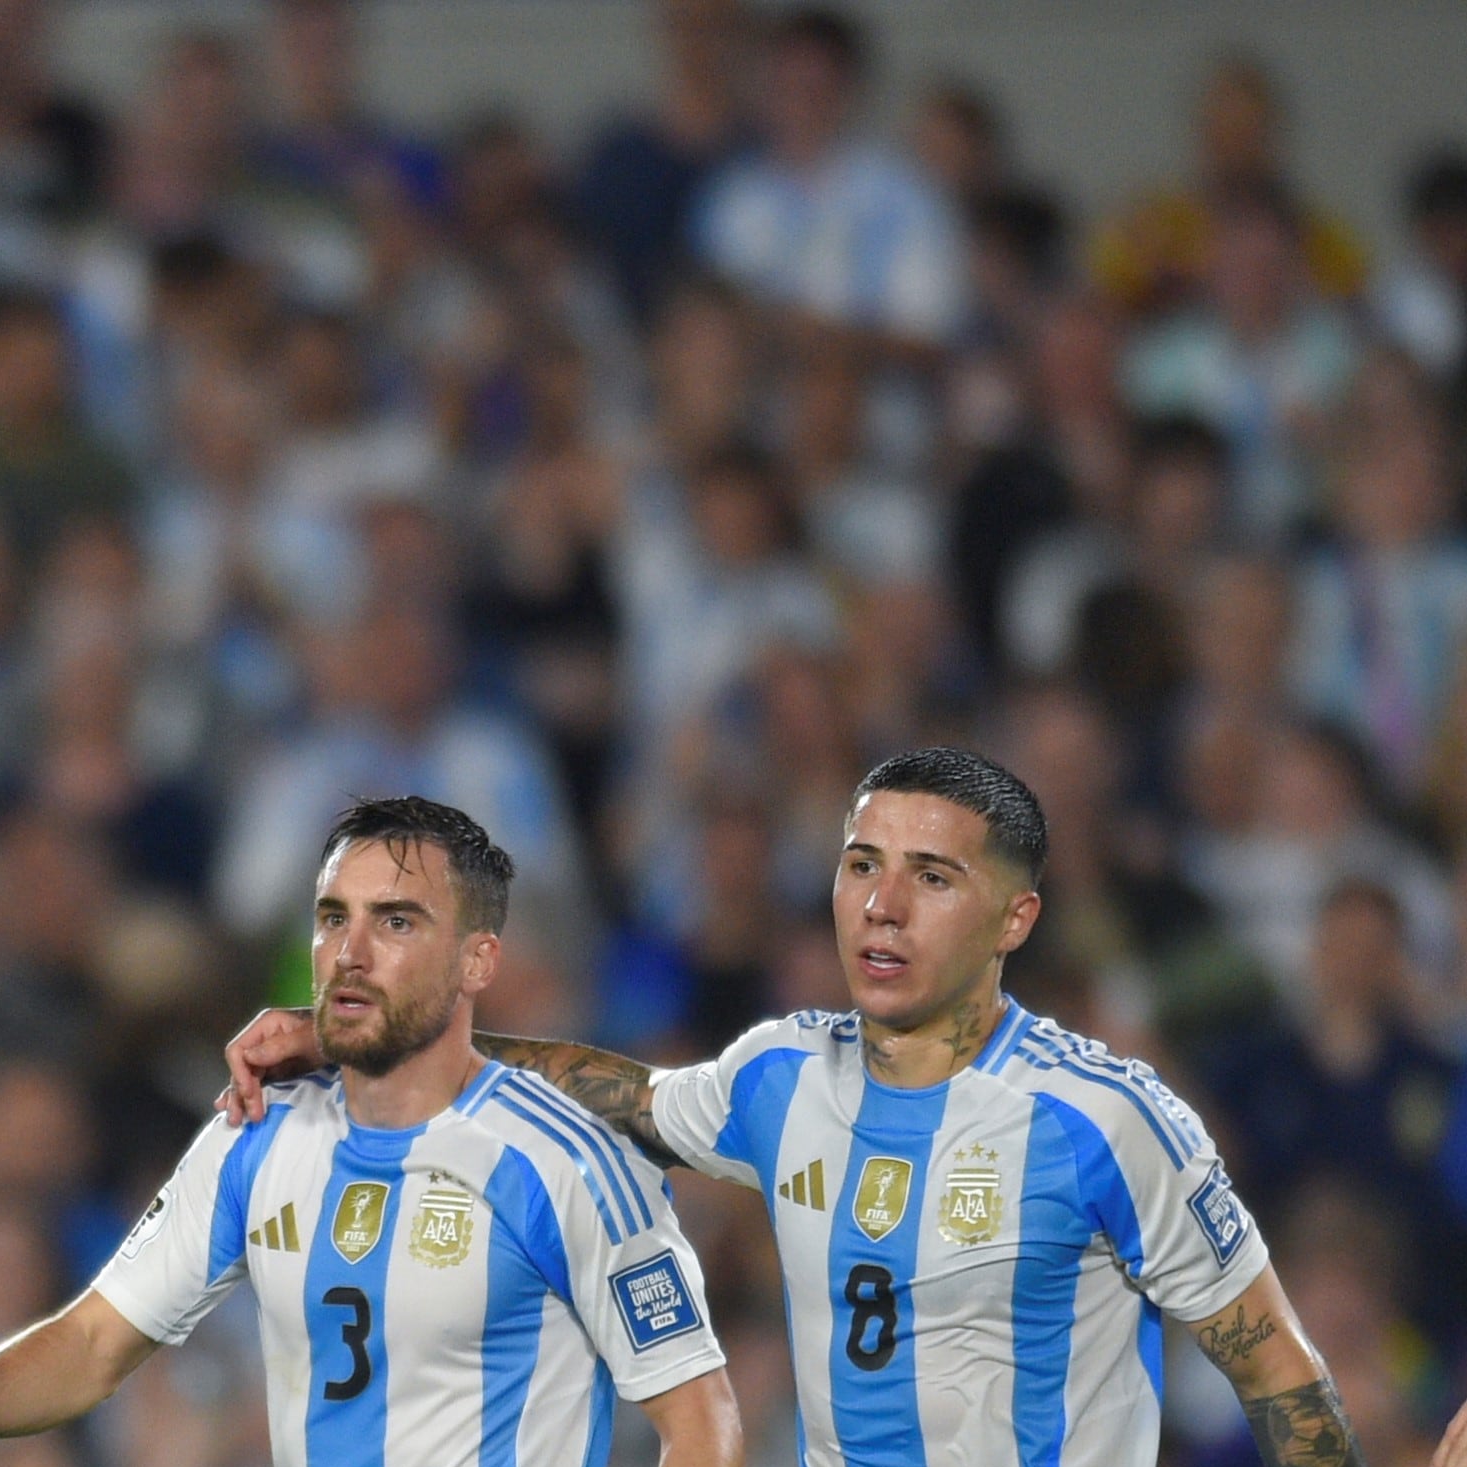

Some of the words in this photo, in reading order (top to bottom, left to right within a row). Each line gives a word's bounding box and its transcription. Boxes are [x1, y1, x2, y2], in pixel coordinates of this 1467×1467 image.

[867, 1208, 888, 1221] FIFA
[951, 1188, 987, 1225] AFA
[344, 1230, 367, 1241] FIFA
[422, 1210, 458, 1246] AFA
[627, 1268, 671, 1293] FOOTBALL
[630, 1280, 676, 1307] UNITES
[633, 1307, 652, 1321] the
[654, 1315, 673, 1327] FIFA
[844, 1263, 898, 1372] 8
[322, 1287, 372, 1401] 3
